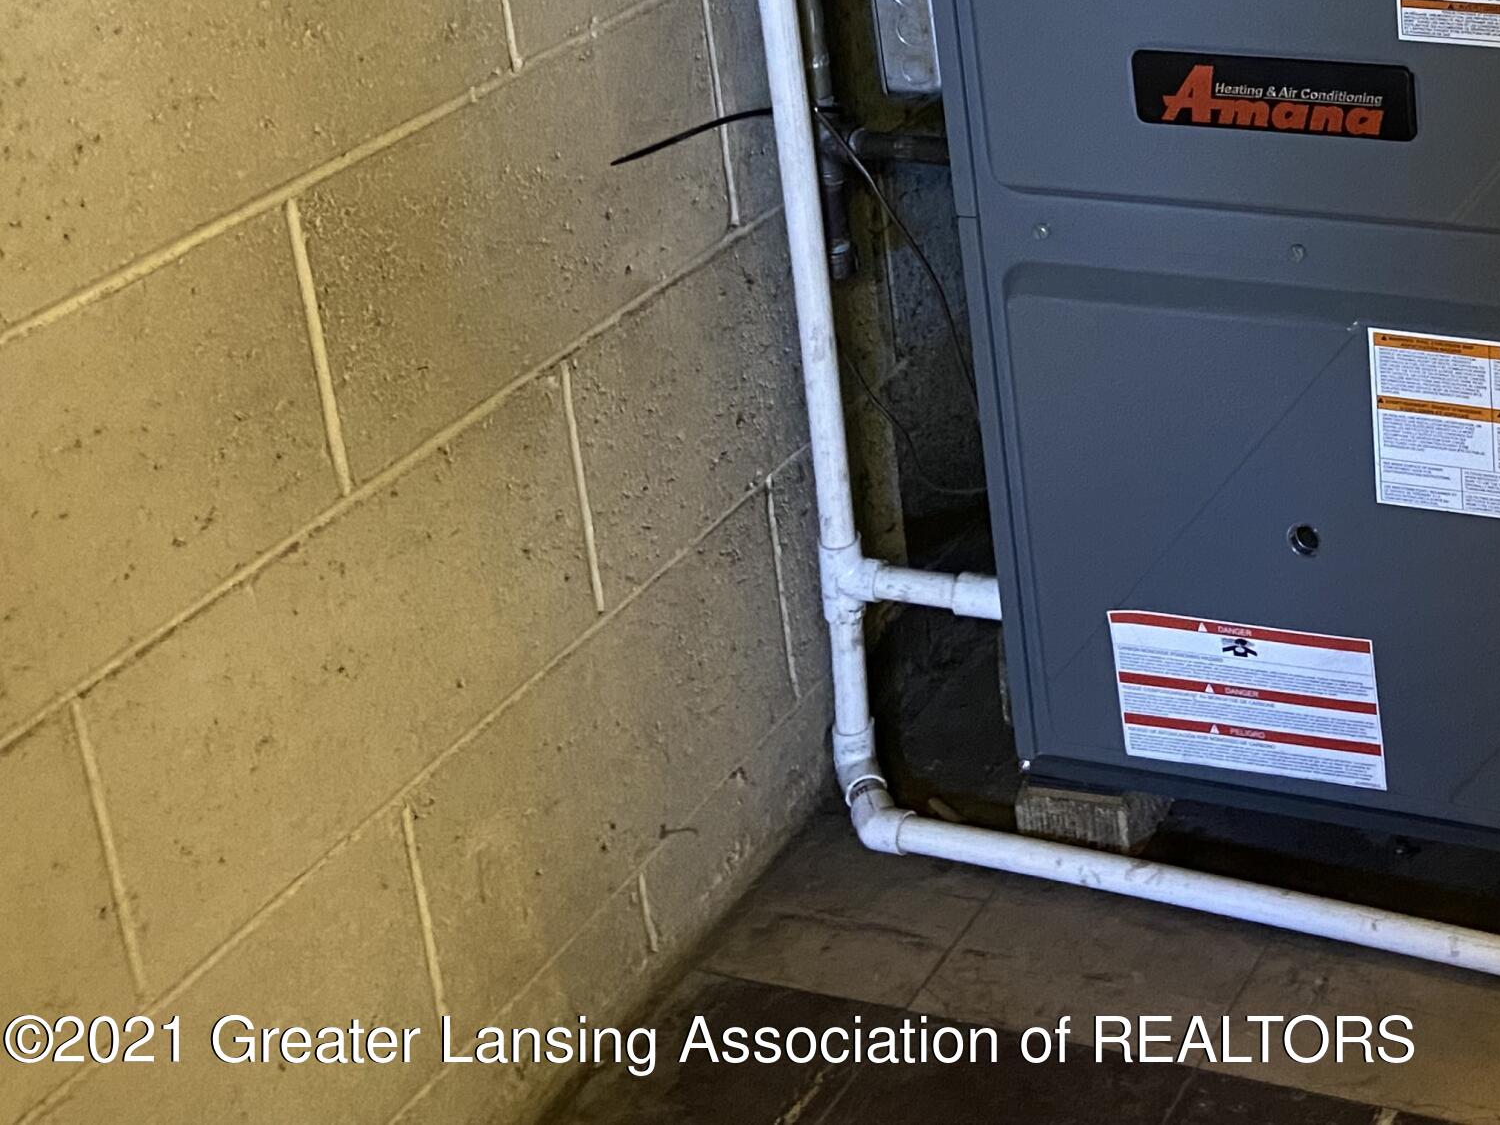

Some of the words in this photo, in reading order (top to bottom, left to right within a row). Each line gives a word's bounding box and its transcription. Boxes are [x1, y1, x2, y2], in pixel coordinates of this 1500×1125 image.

[1161, 64, 1384, 136] Amana
[1215, 82, 1263, 98] Heating
[1267, 83, 1277, 97] &
[1278, 85, 1298, 99] Air
[1300, 88, 1384, 107] Conditioning
[1217, 625, 1252, 636] DANGER
[1224, 687, 1259, 698] DANGER
[1230, 726, 1265, 739] PELIGRO
